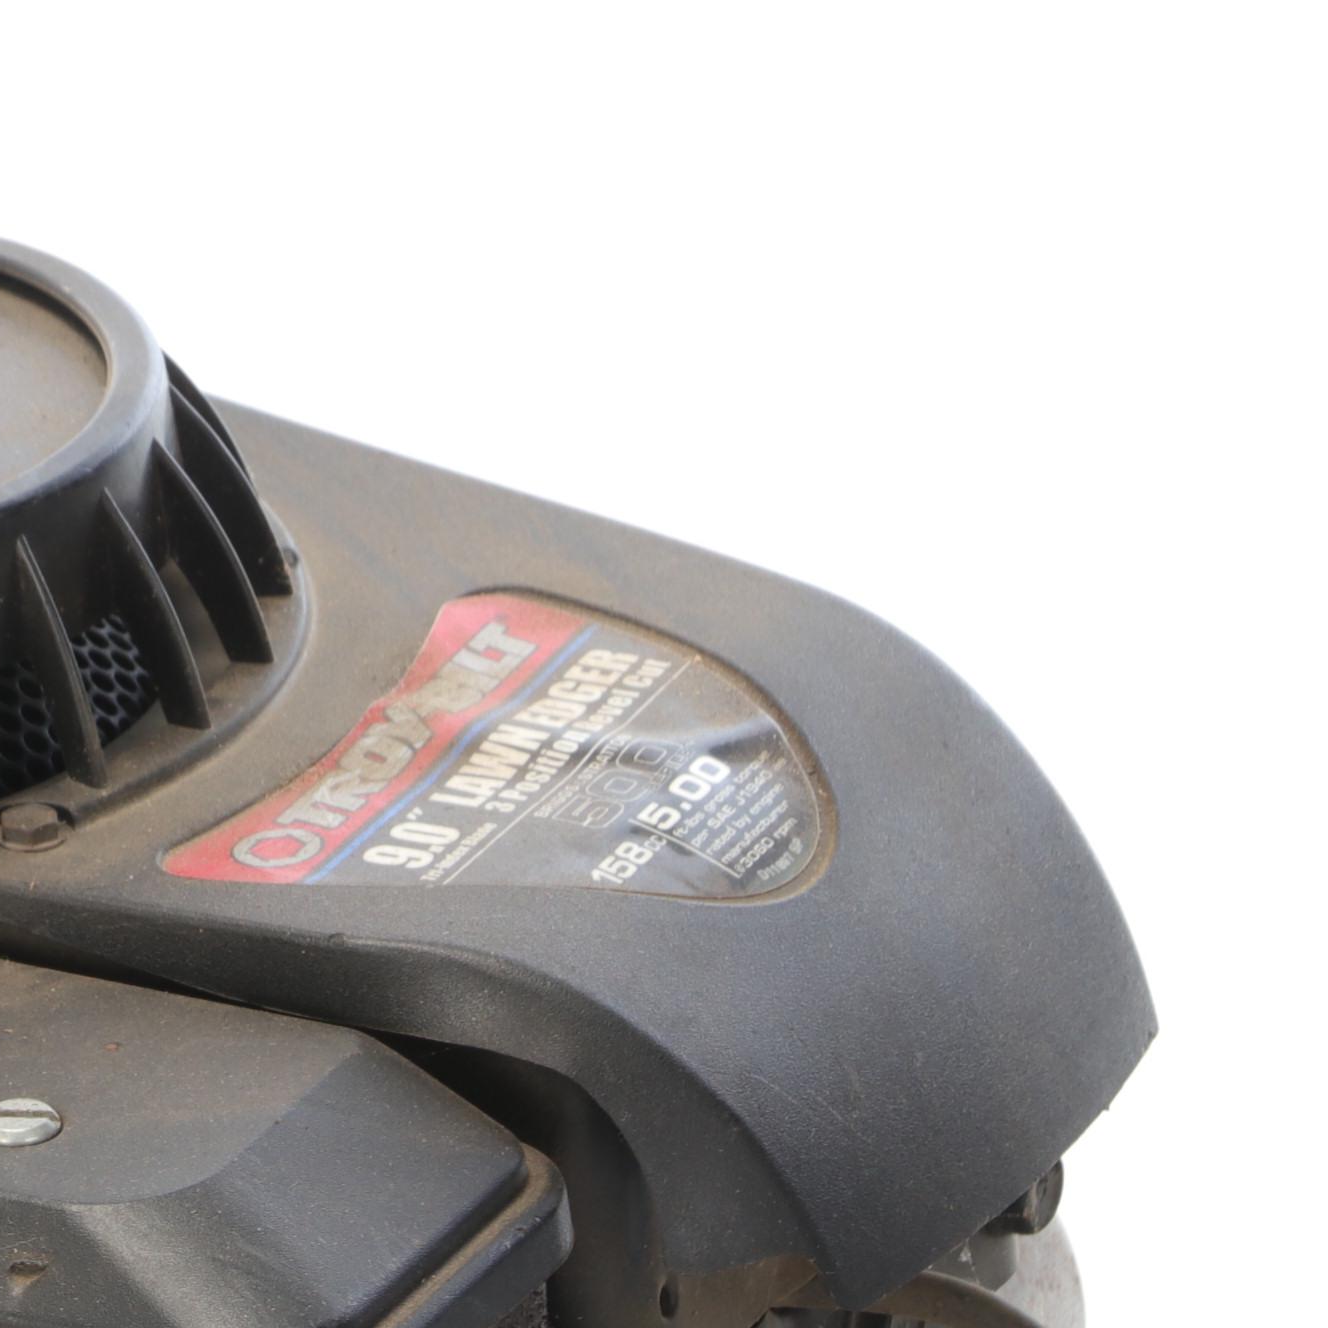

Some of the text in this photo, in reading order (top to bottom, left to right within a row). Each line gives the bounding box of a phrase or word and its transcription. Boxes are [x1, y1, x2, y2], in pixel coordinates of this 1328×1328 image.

[429, 724, 551, 808] LAWN
[512, 649, 640, 729] EDGER
[499, 729, 591, 801] Position
[637, 755, 731, 831] 5.00
[705, 783, 784, 855] rated by engine
[707, 804, 736, 829] SAE
[721, 800, 788, 864] manufacturer
[773, 817, 798, 840] rpm
